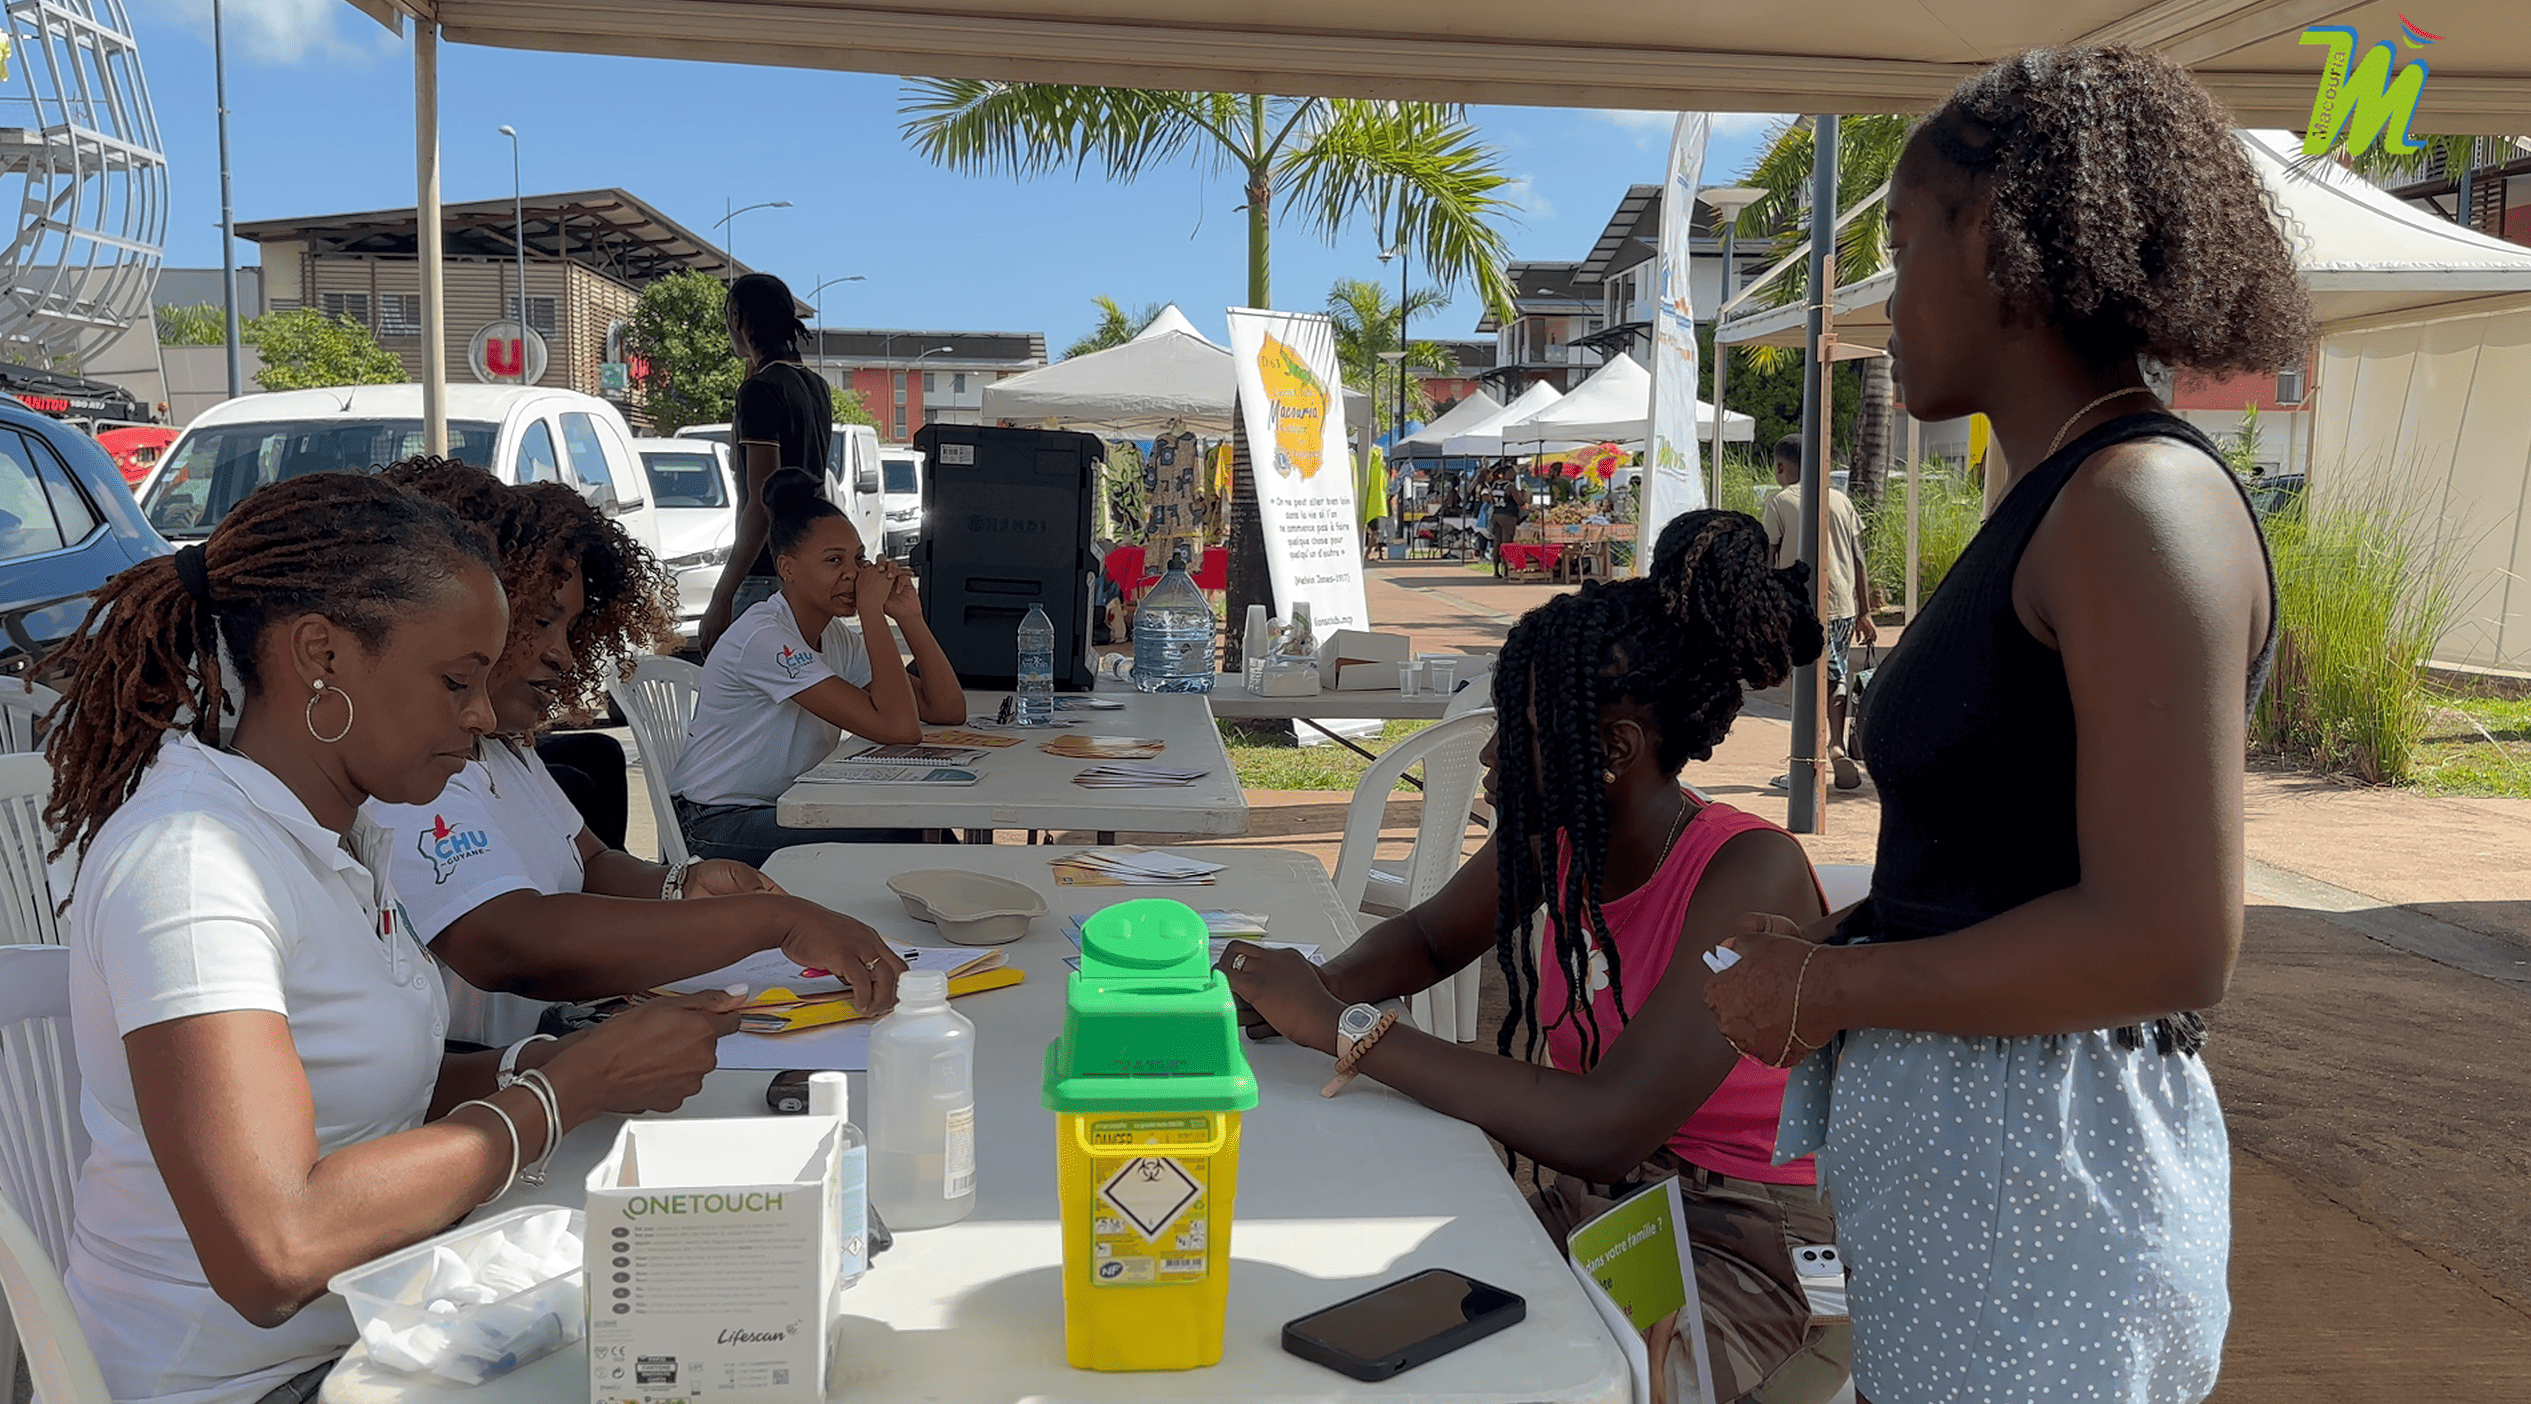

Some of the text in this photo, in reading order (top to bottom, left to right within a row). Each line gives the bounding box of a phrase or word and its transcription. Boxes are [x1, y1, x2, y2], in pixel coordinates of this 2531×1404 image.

[487, 338, 522, 376] U
[1267, 400, 1318, 431] Macouria
[786, 651, 813, 667] CHU
[434, 830, 488, 860] CHU
[627, 1192, 784, 1217] ONETOUCH
[1604, 1241, 1628, 1263] votre
[1628, 1222, 1656, 1248] famille
[1101, 1263, 1121, 1277] NF
[716, 1327, 786, 1347] Lifescan
